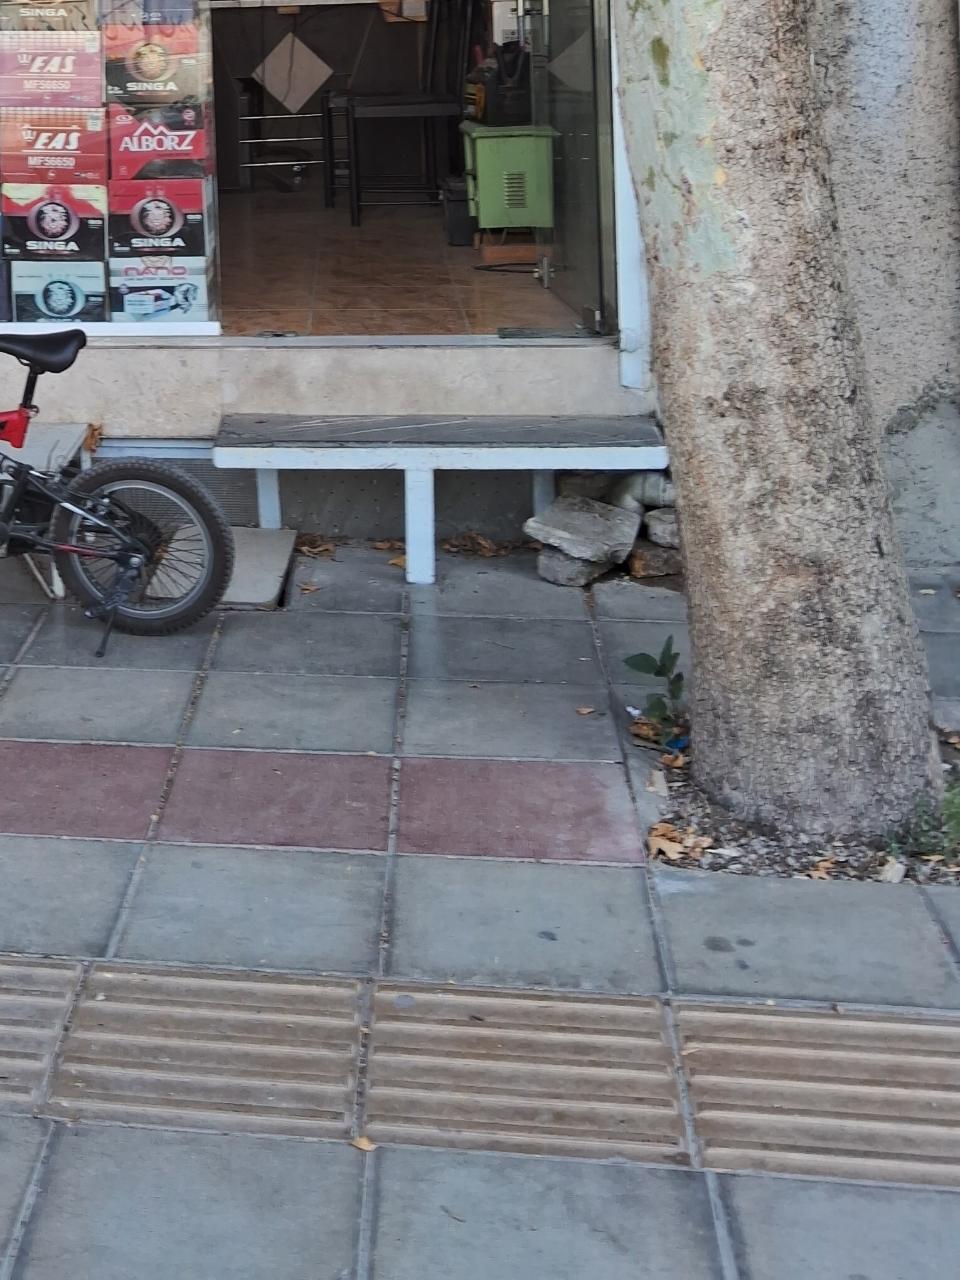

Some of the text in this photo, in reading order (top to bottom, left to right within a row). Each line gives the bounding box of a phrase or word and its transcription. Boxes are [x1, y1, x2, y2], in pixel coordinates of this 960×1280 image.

[19, 8, 68, 18] SINGA
[125, 81, 179, 91] SINGA
[119, 131, 196, 151] ALBORZ
[26, 241, 80, 251] SINGA
[131, 238, 186, 247] SINGA
